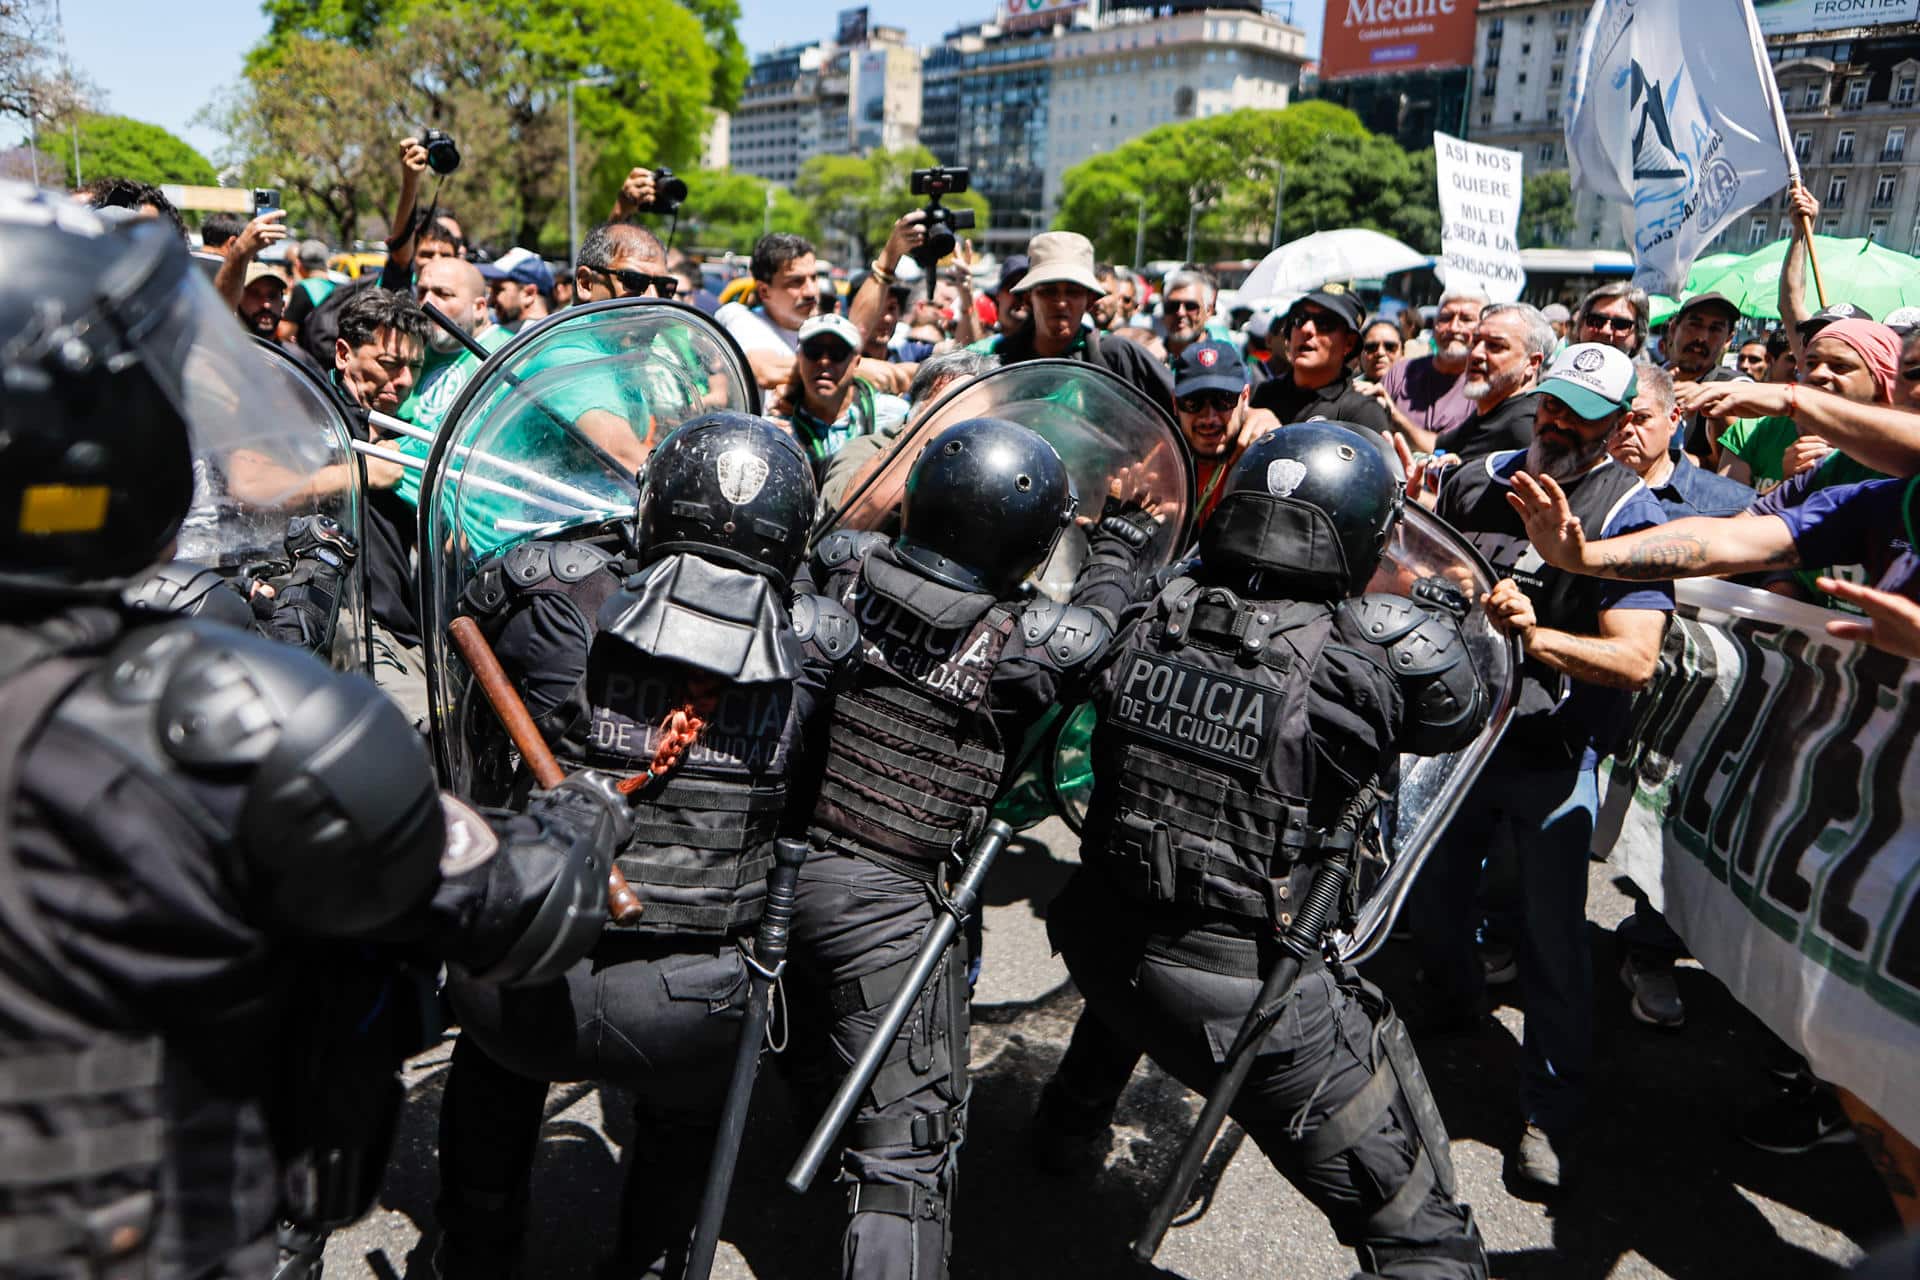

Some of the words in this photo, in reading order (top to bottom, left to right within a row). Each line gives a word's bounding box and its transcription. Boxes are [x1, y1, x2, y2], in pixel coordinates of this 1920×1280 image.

[1476, 150, 1511, 172] NOS
[1452, 172, 1512, 199] QUIERE
[1461, 204, 1505, 225] MILEI
[1124, 657, 1265, 737] POLICIA
[597, 721, 634, 751] DE
[1118, 695, 1146, 724] DE
[1146, 704, 1171, 735] LA
[1175, 714, 1260, 760] CIUDAD
